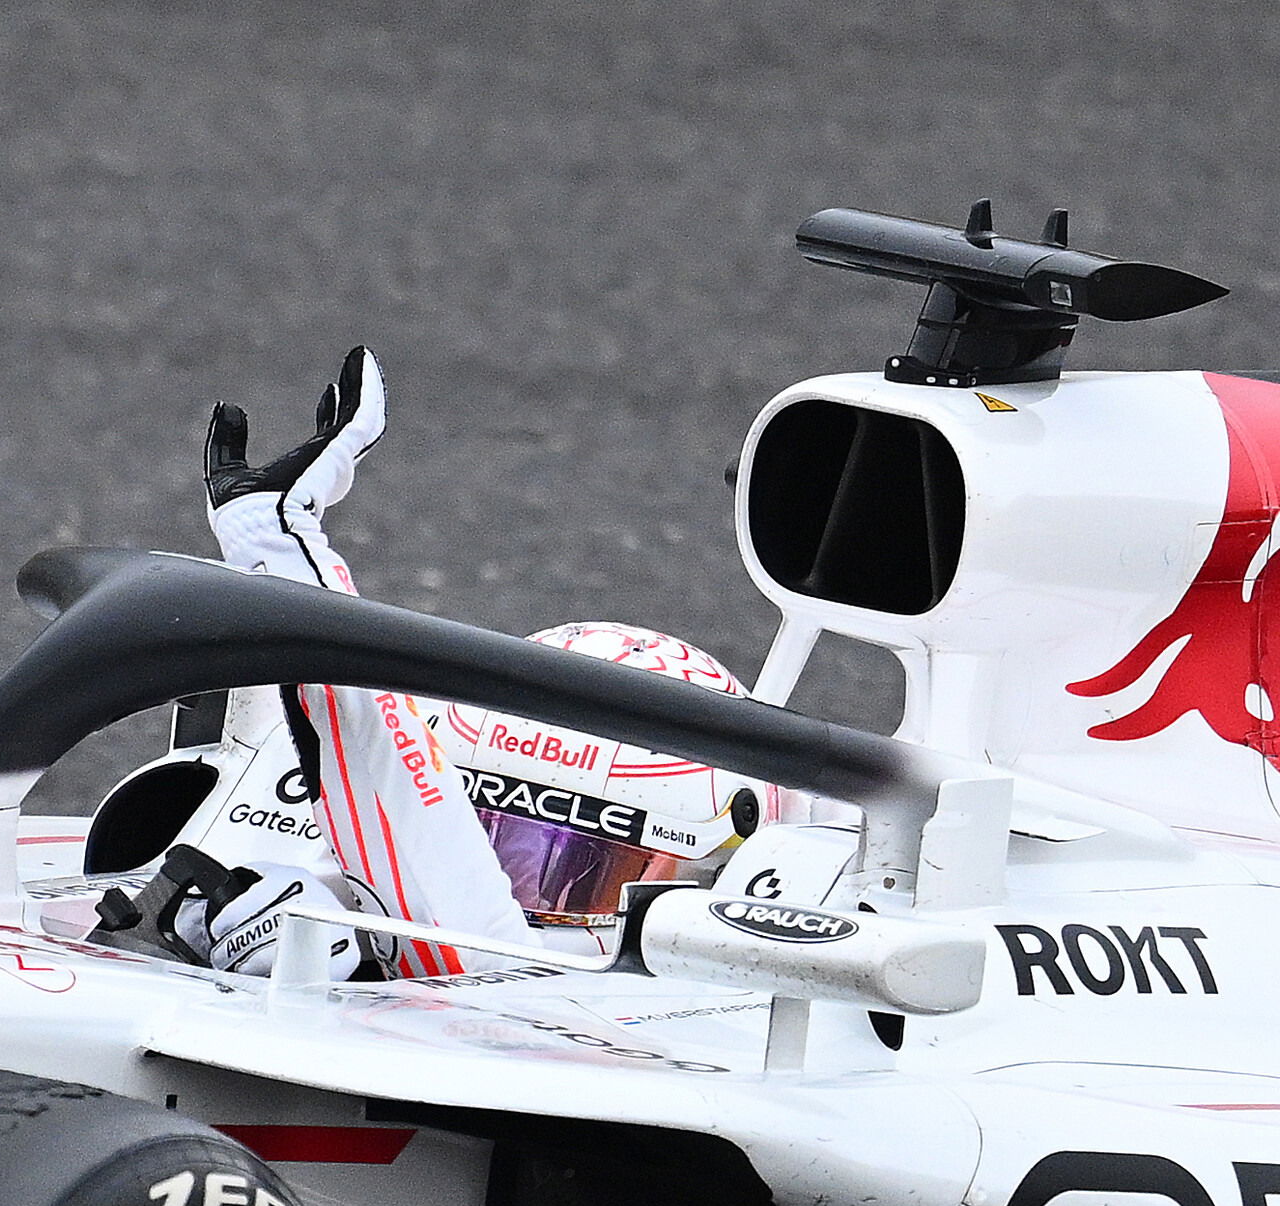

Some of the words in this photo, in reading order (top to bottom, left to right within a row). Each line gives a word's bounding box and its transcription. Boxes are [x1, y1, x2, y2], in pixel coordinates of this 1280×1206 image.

[488, 724, 542, 758] Red
[540, 734, 599, 771] Bull
[401, 750, 444, 807] Bull
[229, 803, 322, 840] Gate.io
[651, 825, 684, 844] Mobil
[746, 907, 844, 936] RAUCH
[995, 924, 1219, 996] ROKT
